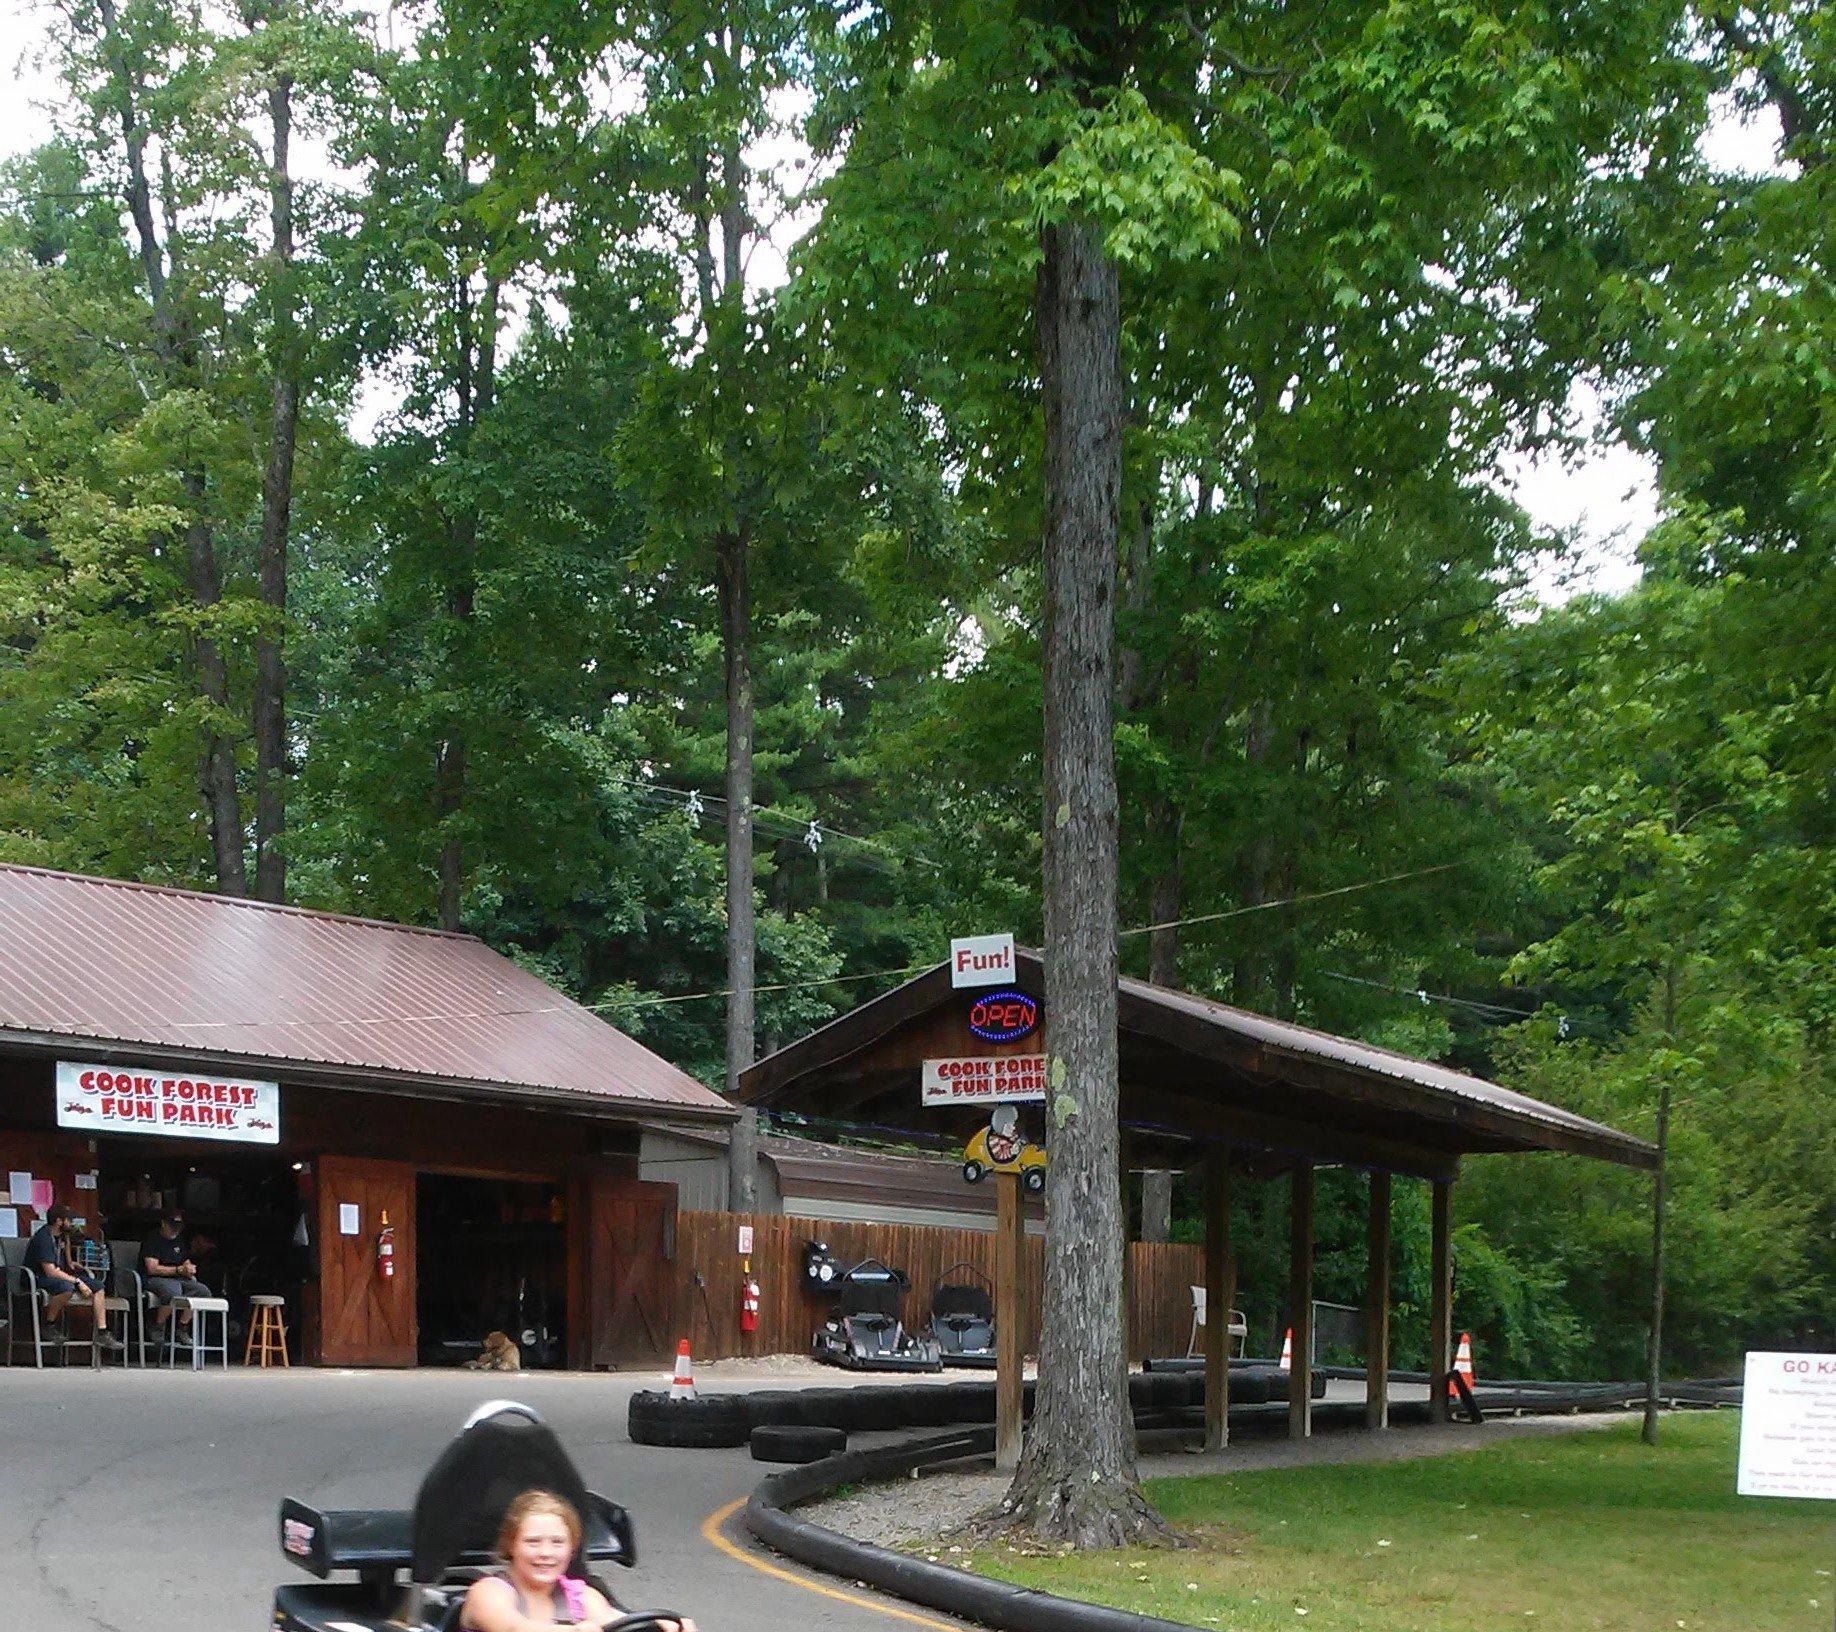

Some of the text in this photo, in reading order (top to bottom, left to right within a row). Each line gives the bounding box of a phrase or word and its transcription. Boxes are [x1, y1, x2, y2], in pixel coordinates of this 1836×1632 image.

[957, 946, 1010, 972] Fun!
[970, 1005, 1036, 1028] OPEN
[938, 1058, 1045, 1079] COOK FORE
[79, 1072, 257, 1108] COOK FOREST
[952, 1078, 991, 1096] FUN
[101, 1098, 237, 1128] FUN PARK
[1783, 1360, 1809, 1373] GO
